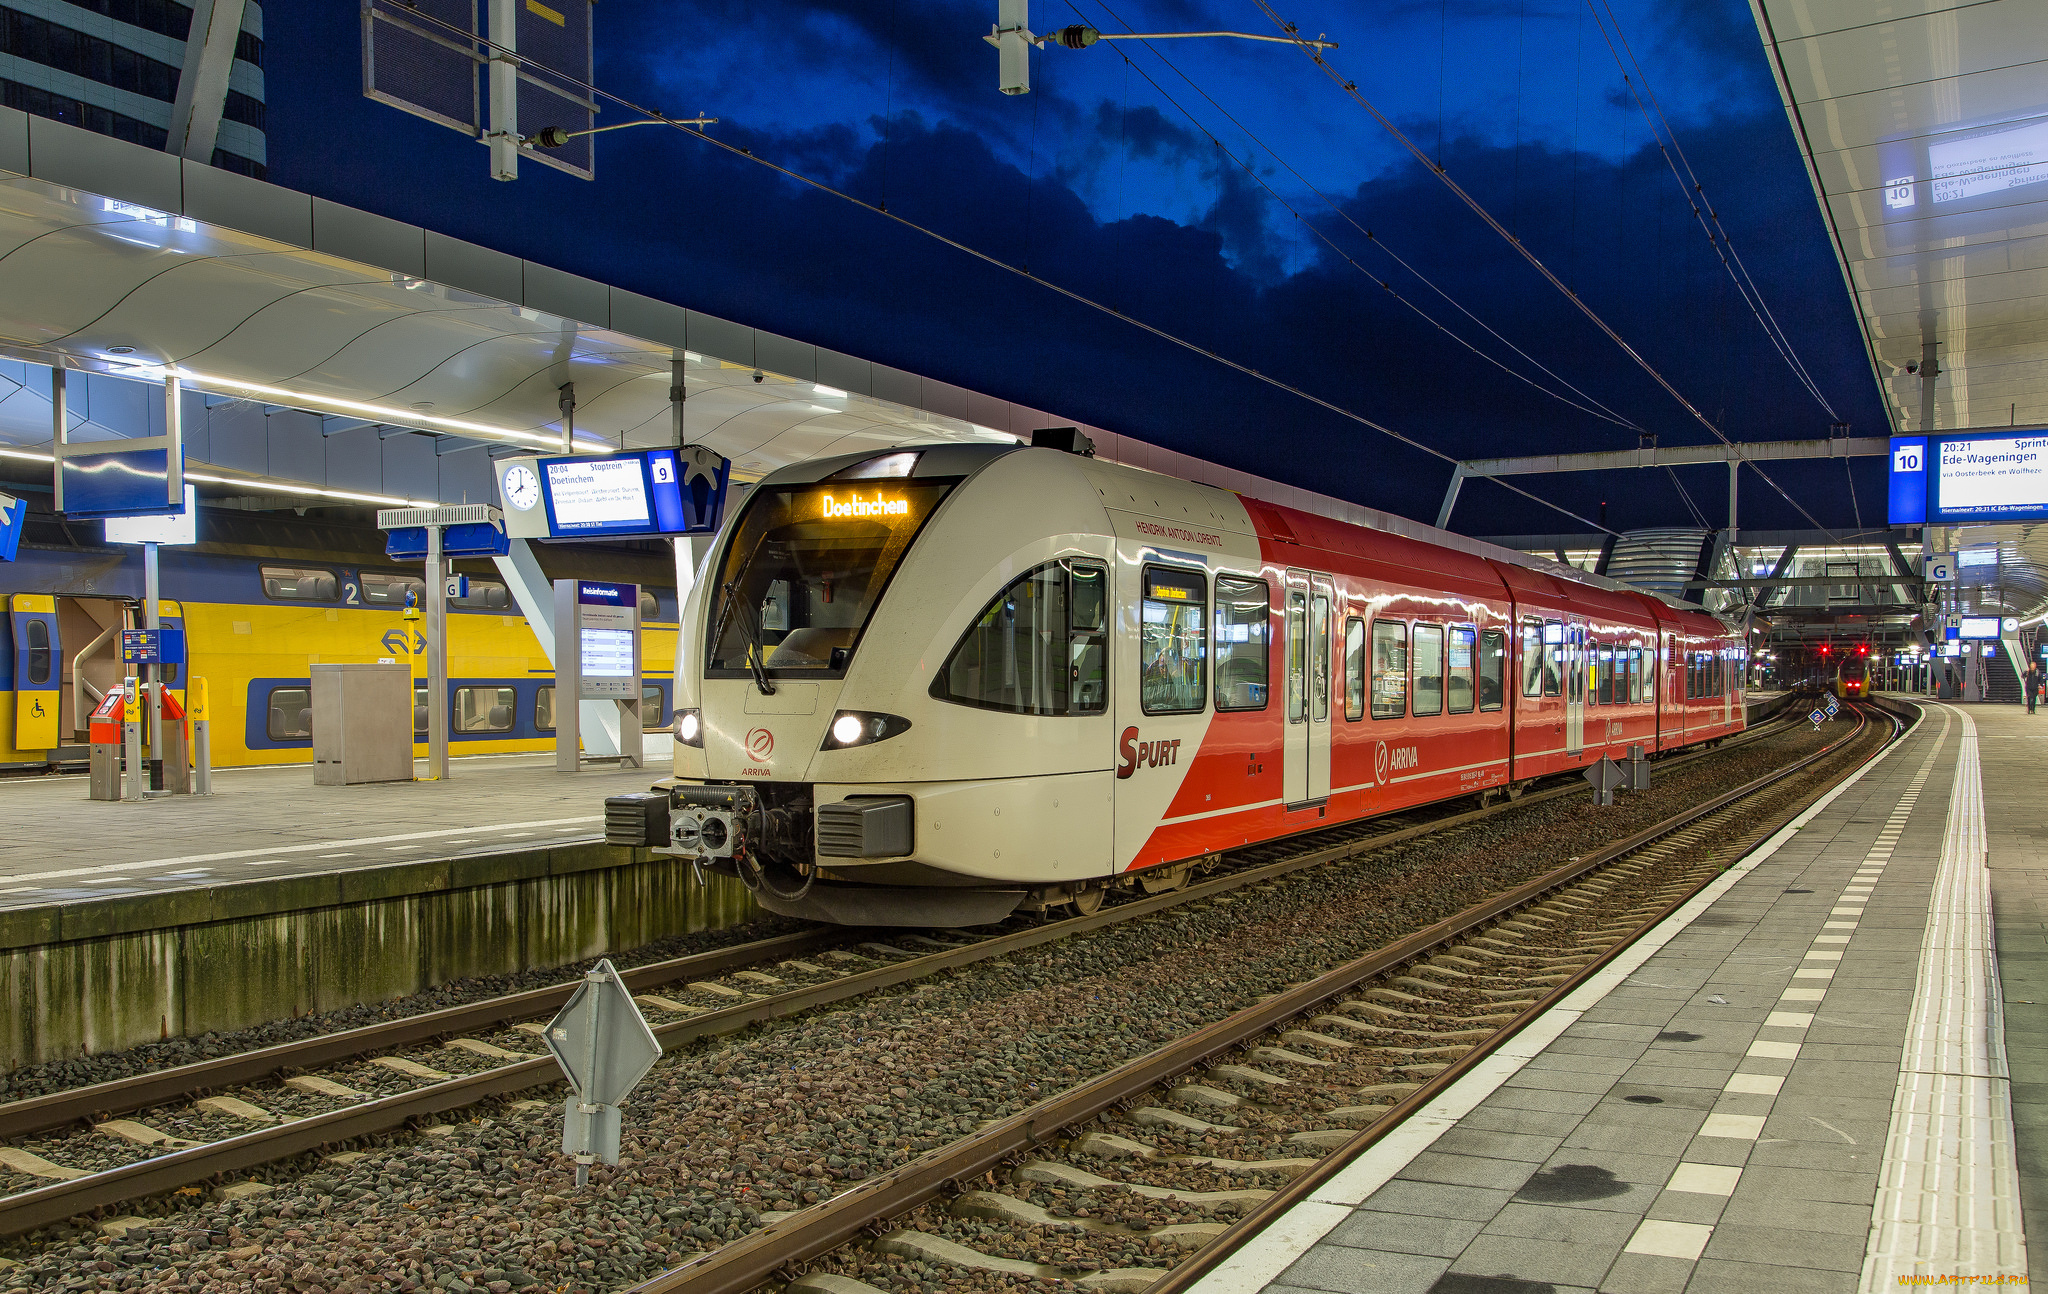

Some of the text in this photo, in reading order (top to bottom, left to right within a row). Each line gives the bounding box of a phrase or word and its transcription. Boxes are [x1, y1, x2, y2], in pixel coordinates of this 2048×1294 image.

[1943, 438, 2048, 452] 20:21 Sprint
[1899, 455, 1918, 469] 10
[1943, 452, 2037, 465] Ede-Wageningen
[550, 465, 568, 474] 20:04
[590, 461, 622, 472] Stoptrein
[659, 467, 667, 480] 9
[1955, 469, 1995, 477] Oosterbeek
[2008, 467, 2042, 475] Wolfheze
[551, 475, 594, 485] Doetinchem
[823, 493, 908, 517] Doetinchem
[1998, 504, 2043, 512] Ede-Wageningen
[1135, 520, 1222, 546] HENDRIK ANTOON LORENTZ
[1933, 565, 1946, 578] G
[345, 583, 359, 605] 2
[447, 584, 455, 596] G
[582, 587, 619, 597] Reisinformatie
[1951, 618, 1958, 626] H
[1390, 746, 1418, 771] ARRIVA
[741, 768, 771, 776] ARRIVA
